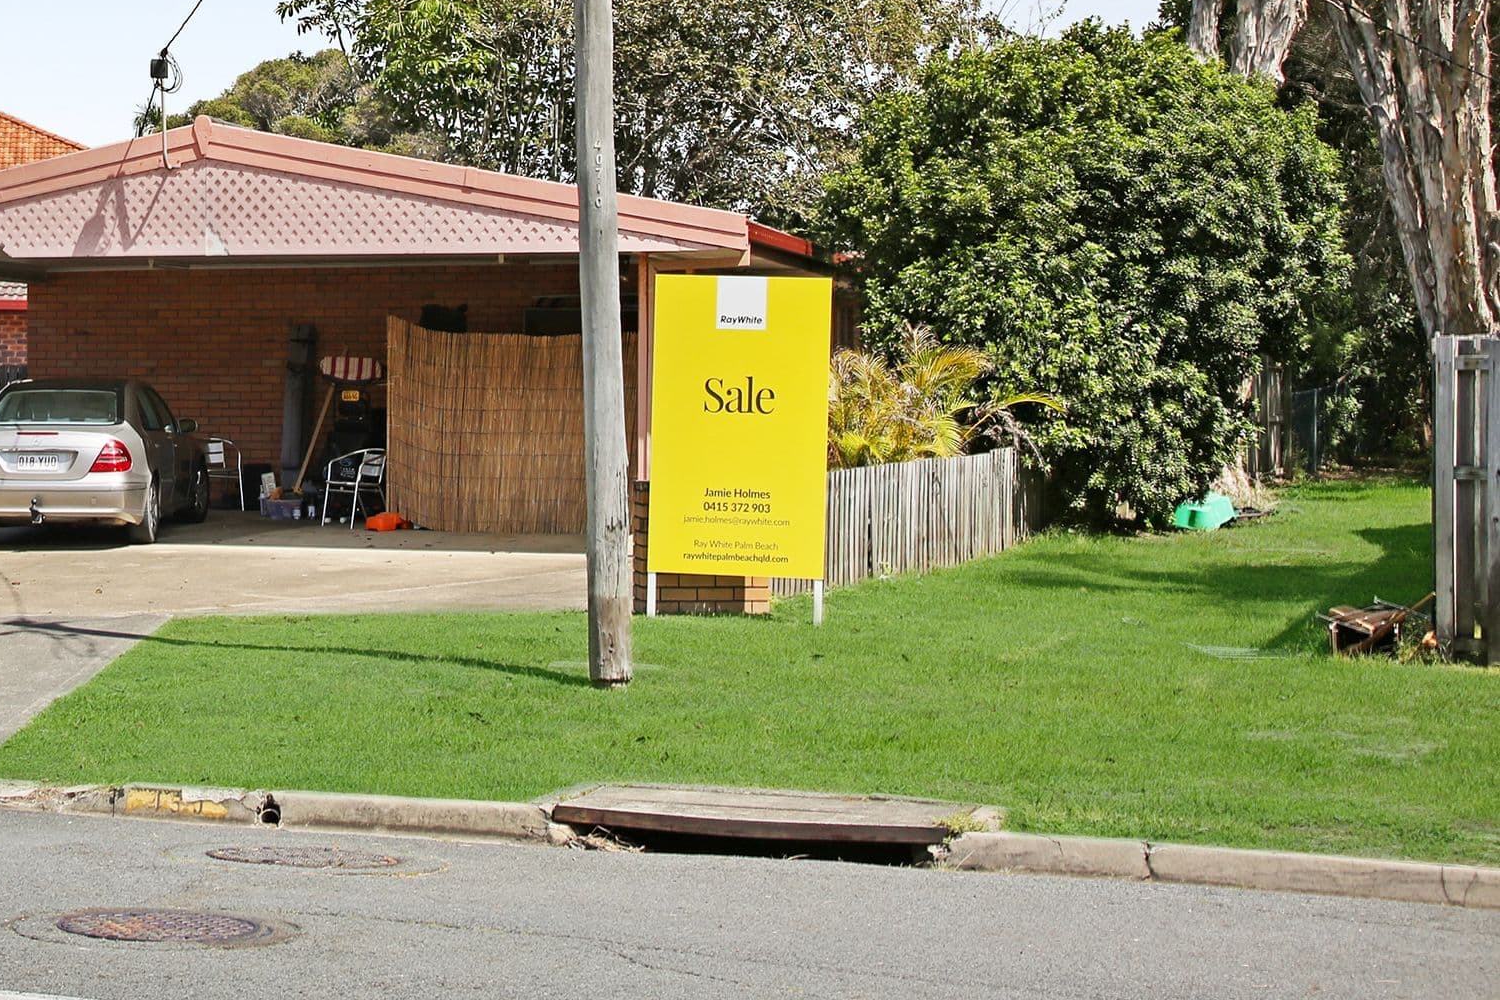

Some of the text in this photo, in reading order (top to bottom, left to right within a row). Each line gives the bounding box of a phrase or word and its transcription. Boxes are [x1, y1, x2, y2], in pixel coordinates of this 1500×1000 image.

[703, 376, 775, 415] Sale
[704, 487, 771, 499] Jamie Holmes
[703, 501, 771, 513] 0415 372 903
[693, 539, 779, 551] Ray White Palm Beach
